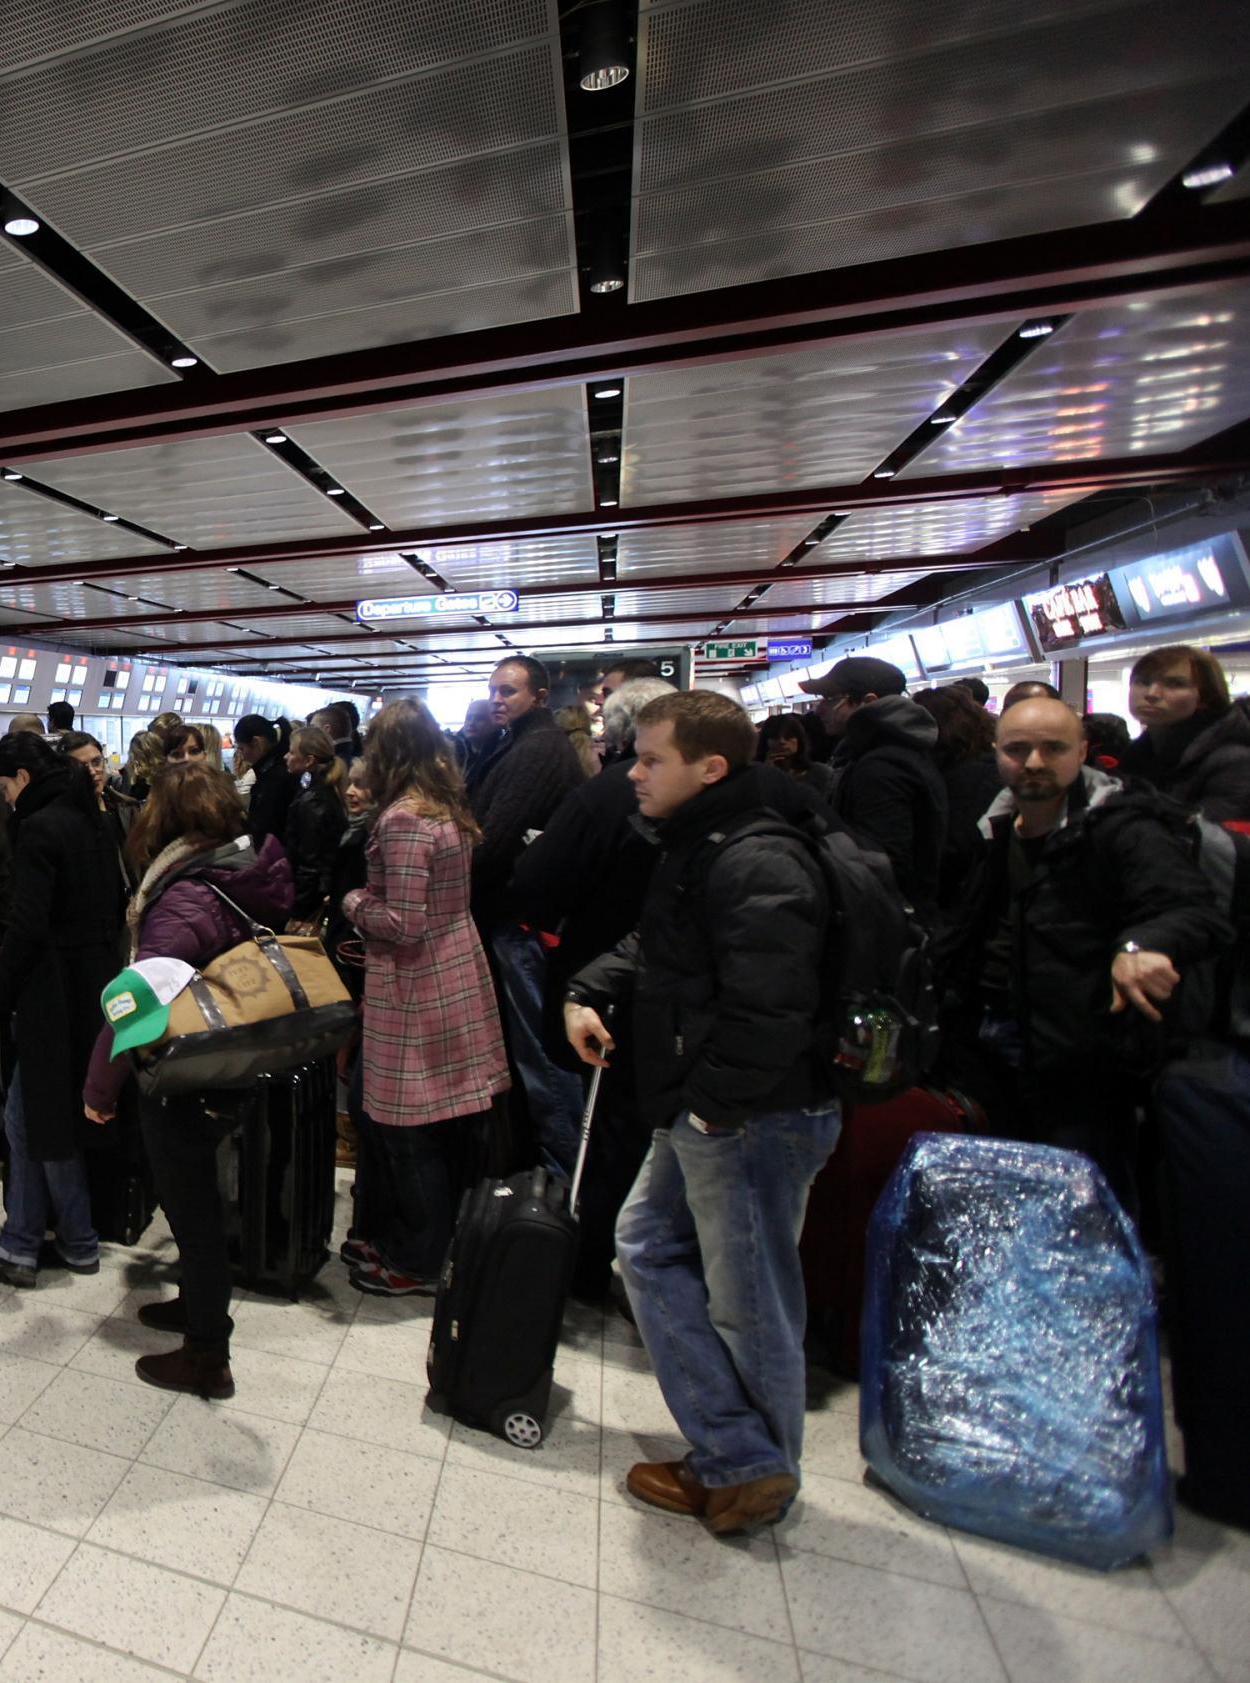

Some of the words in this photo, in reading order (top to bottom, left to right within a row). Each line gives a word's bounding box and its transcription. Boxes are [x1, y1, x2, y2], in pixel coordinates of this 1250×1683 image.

[362, 601, 432, 617] Departure
[435, 597, 478, 610] Gates
[661, 661, 675, 677] 5
